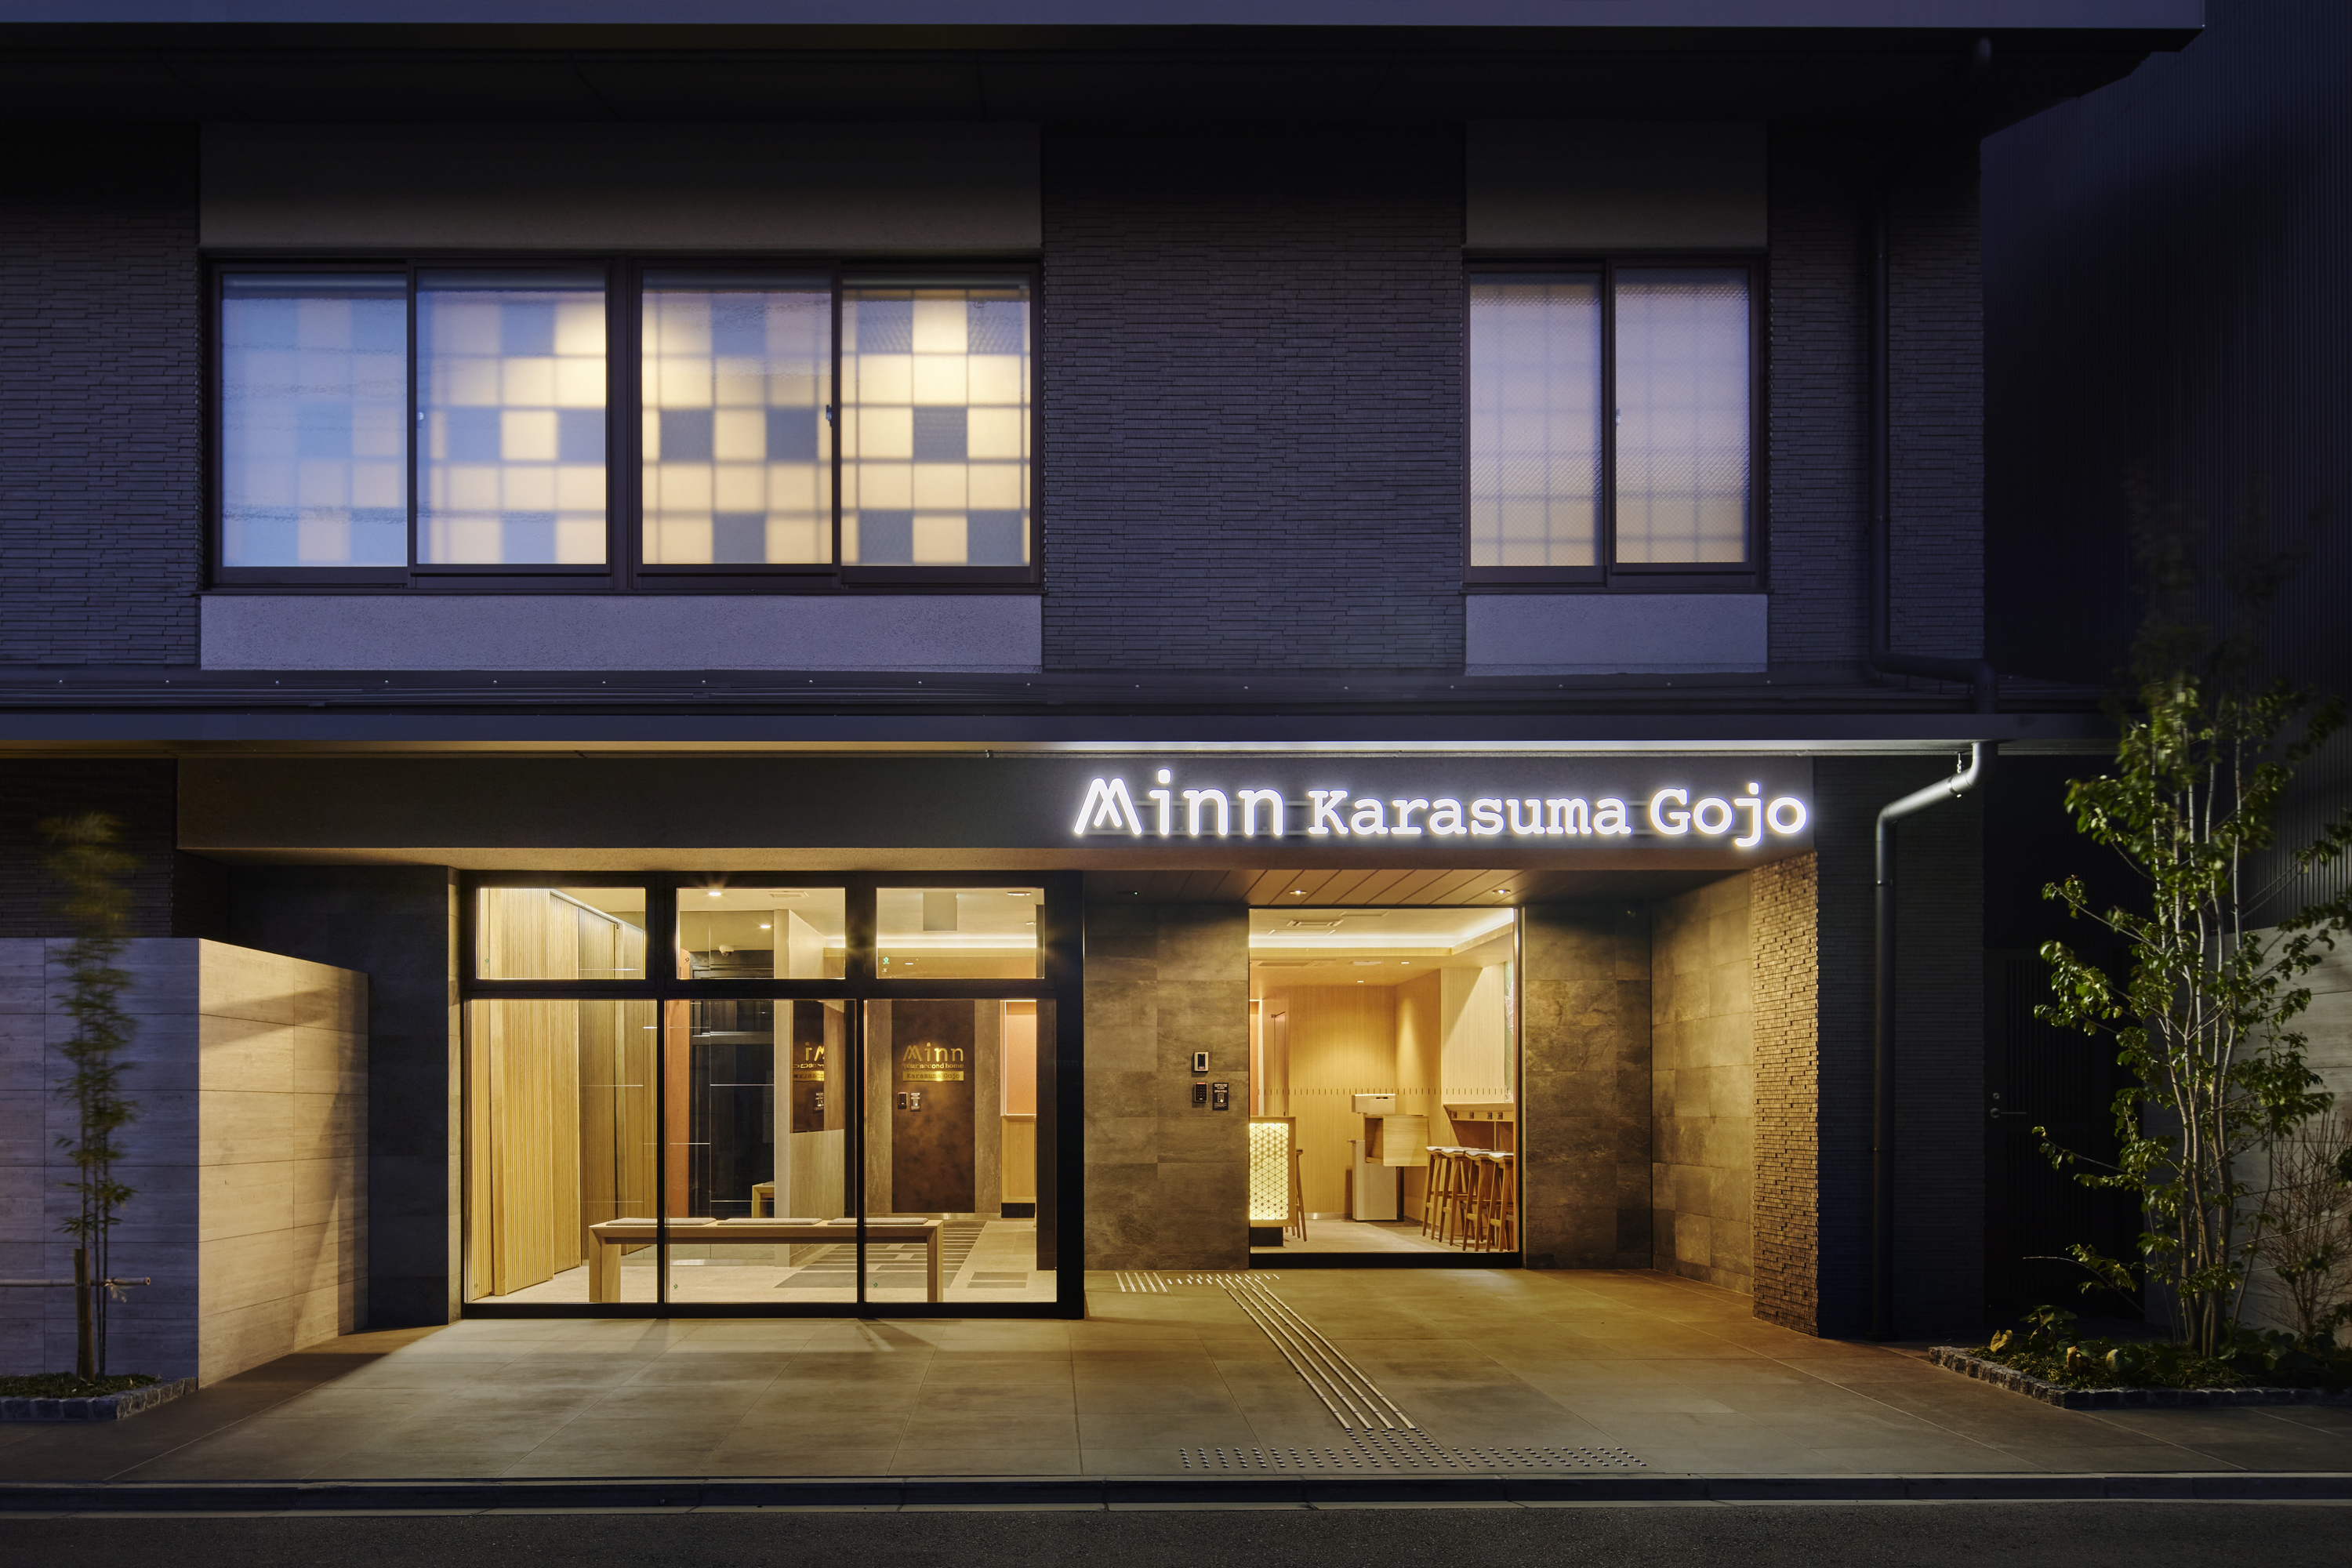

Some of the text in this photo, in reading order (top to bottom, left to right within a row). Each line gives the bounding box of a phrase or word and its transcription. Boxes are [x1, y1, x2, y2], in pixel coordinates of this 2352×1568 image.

[1073, 768, 1809, 848] Minn Karasuma Gojo
[902, 1042, 964, 1062] Minn
